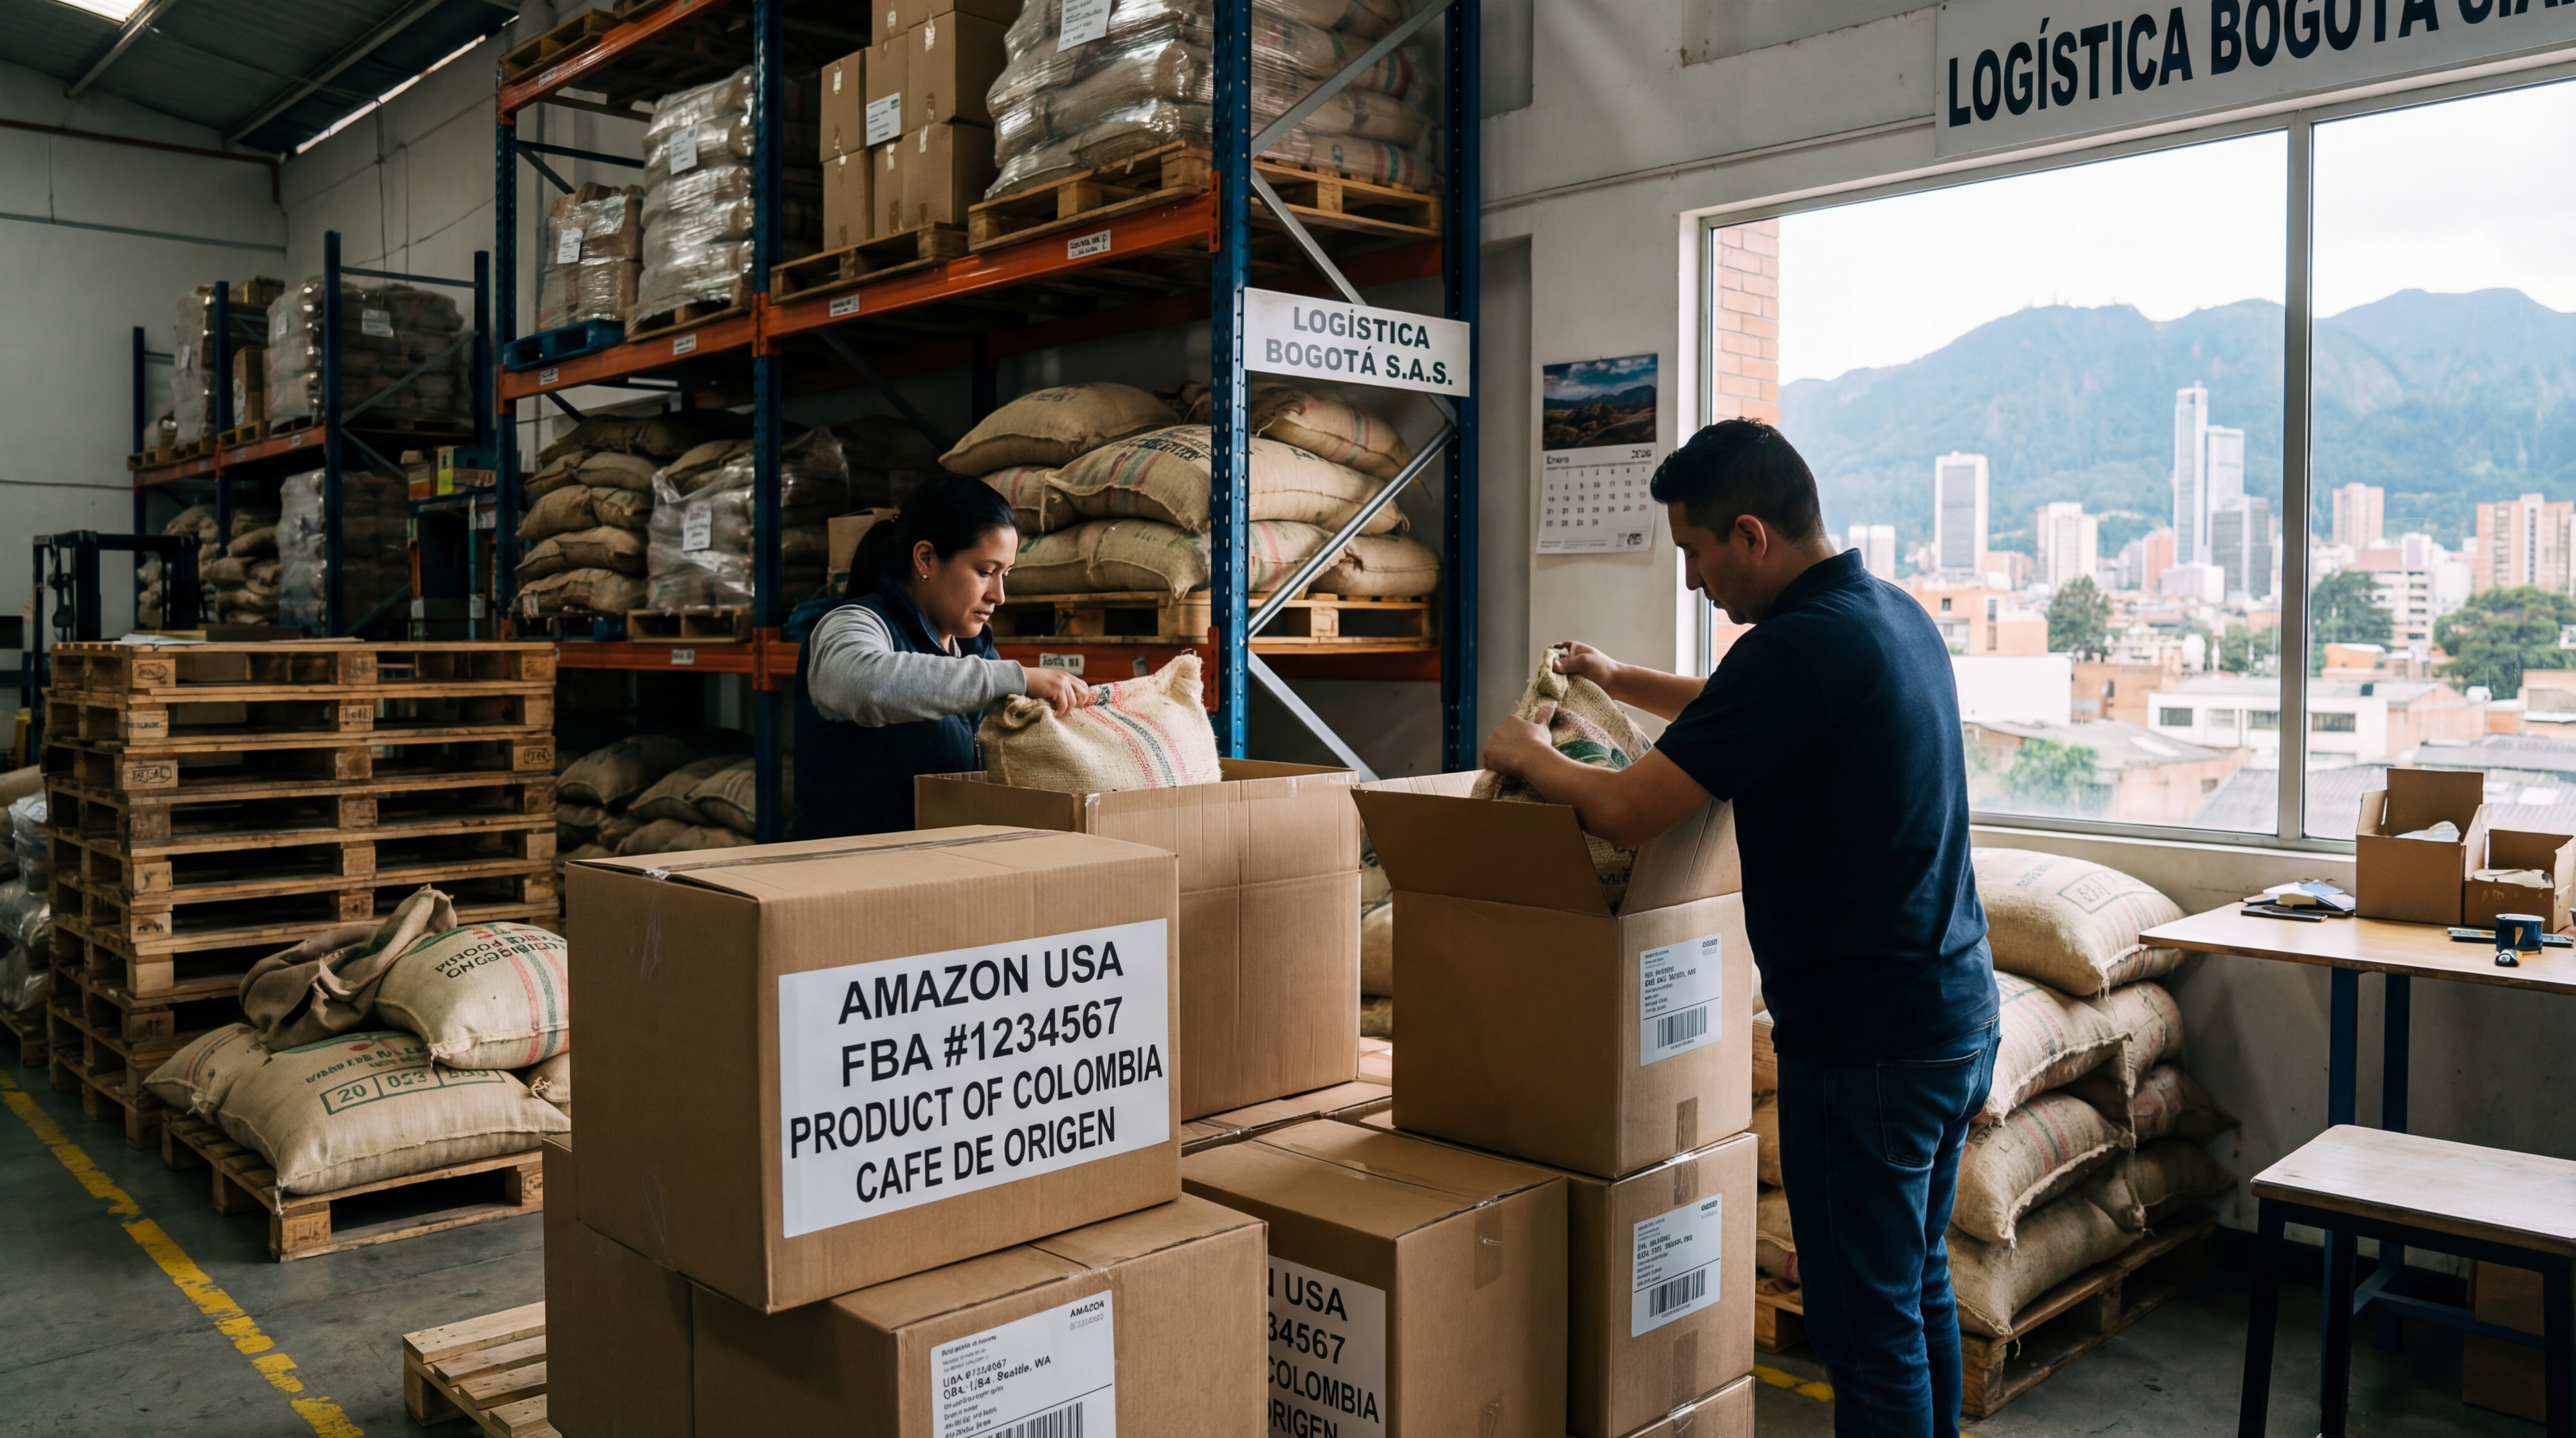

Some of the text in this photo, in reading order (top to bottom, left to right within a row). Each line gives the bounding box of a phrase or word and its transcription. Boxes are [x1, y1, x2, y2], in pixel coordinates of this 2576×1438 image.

[1949, 7, 2193, 128] LOGÍSTICA
[1294, 306, 1431, 350] LOGÍSTICA
[1266, 338, 1454, 387] BOGOTÁ S.A.S.
[838, 941, 1124, 1025] AMAZON USA
[842, 996, 1122, 1087] FBA #1234567
[337, 1084, 367, 1103] 20
[790, 1044, 1163, 1159] PRODUCT OF COLOMBIA
[856, 1106, 1115, 1203] CAFE DE ORIGEN
[1285, 1272, 1348, 1321] USA
[1035, 1355, 1052, 1368] WA
[1268, 1398, 1338, 1438] RIGEN
